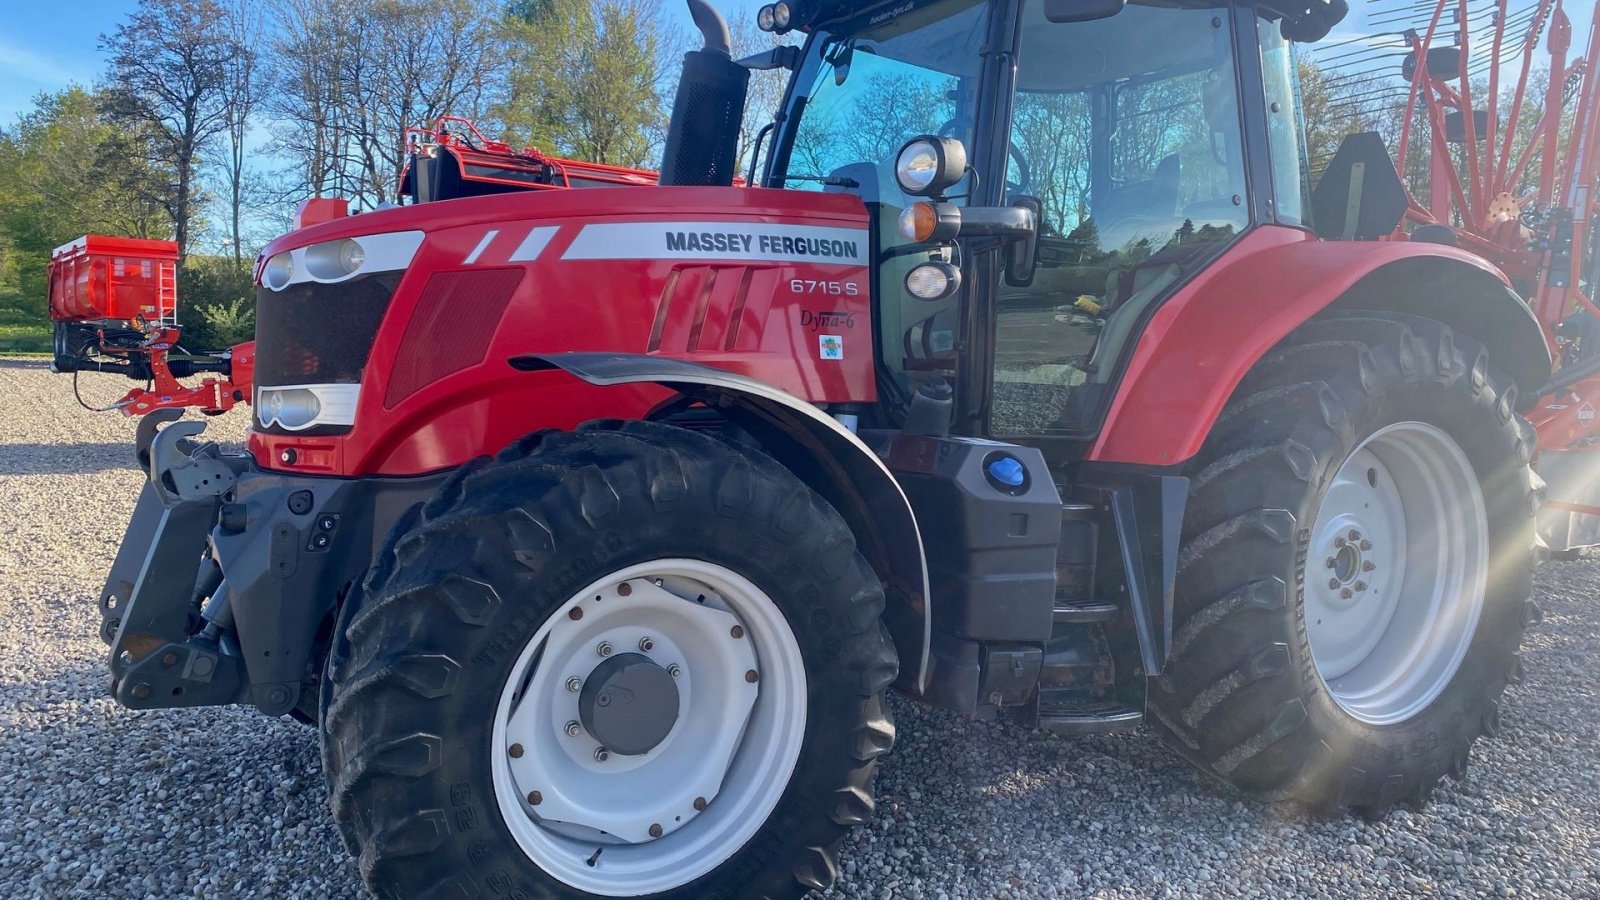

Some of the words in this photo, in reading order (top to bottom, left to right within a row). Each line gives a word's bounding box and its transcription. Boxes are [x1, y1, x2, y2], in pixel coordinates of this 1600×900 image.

[666, 231, 752, 252] MASSEY
[759, 235, 858, 258] FERGUSON
[790, 279, 841, 295] 6715
[845, 282, 858, 296] S
[800, 310, 855, 332] Dyna-6
